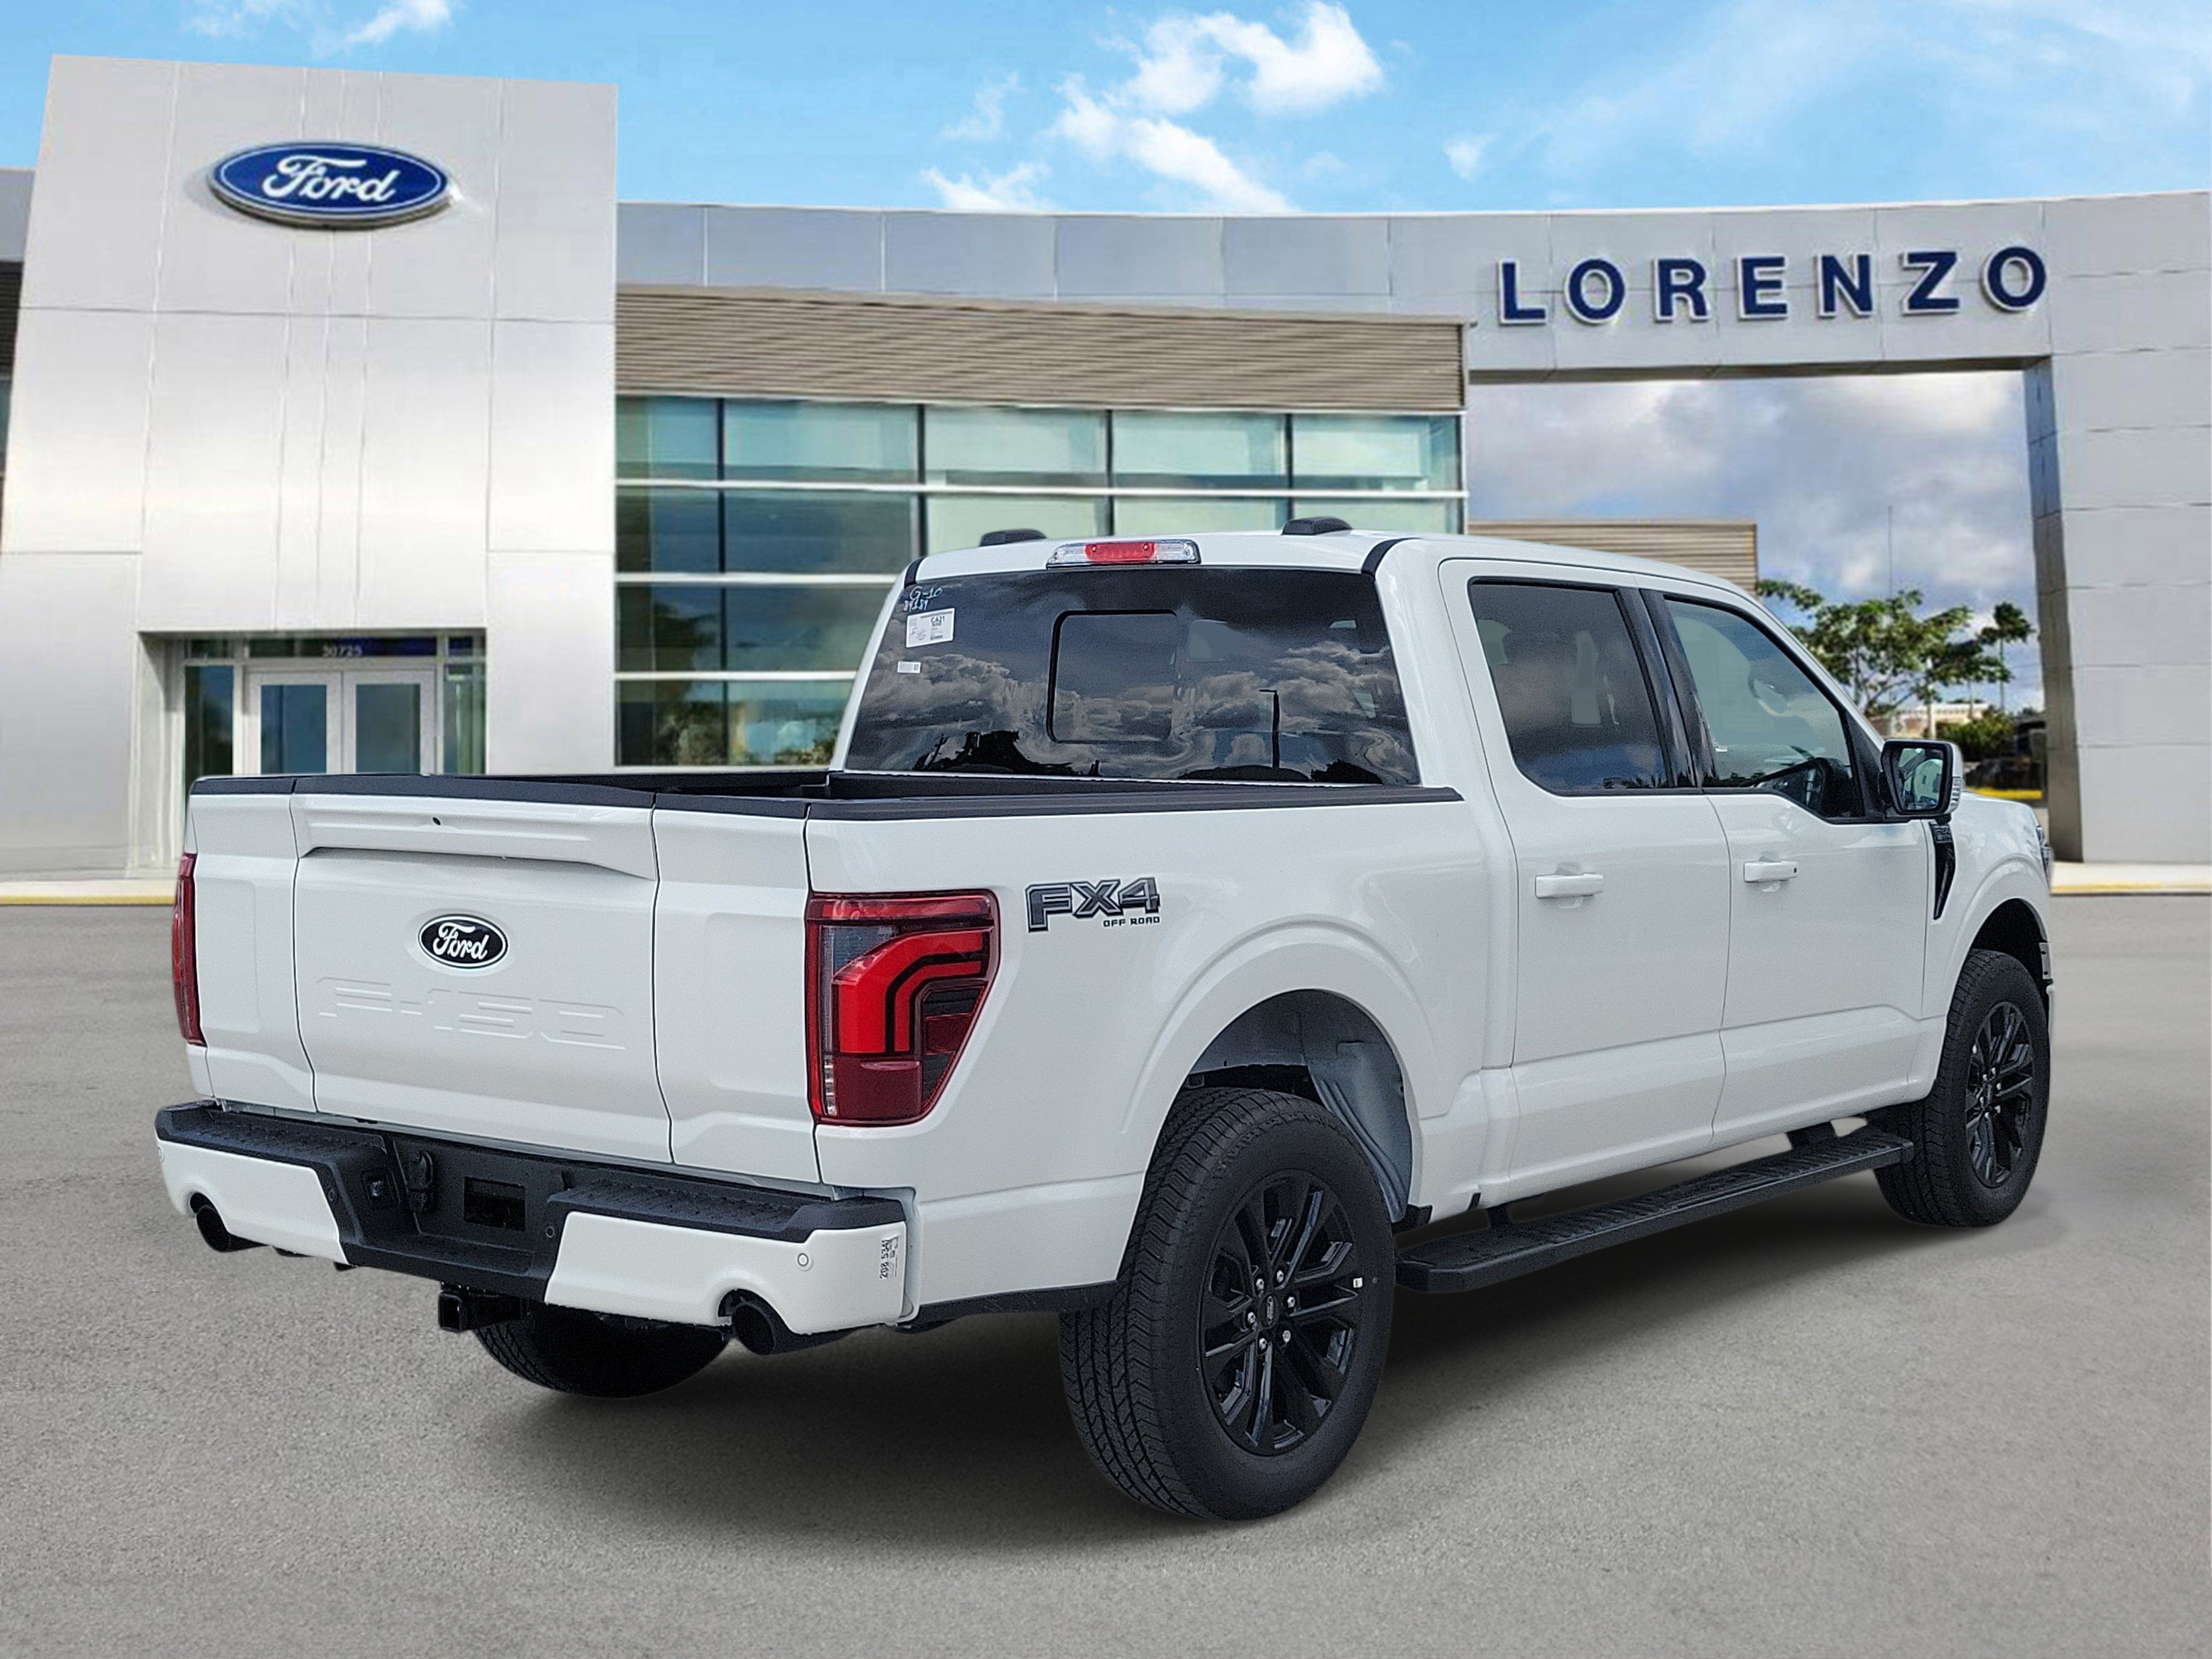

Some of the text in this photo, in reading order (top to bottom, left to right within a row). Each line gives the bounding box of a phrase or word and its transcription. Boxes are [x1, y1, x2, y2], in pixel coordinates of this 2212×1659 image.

[263, 155, 400, 202] Ford
[1496, 246, 2047, 326] LORENZO
[1025, 877, 1160, 933] FX4
[1103, 916, 1160, 927] OFF ROAD
[432, 921, 490, 960] Ford
